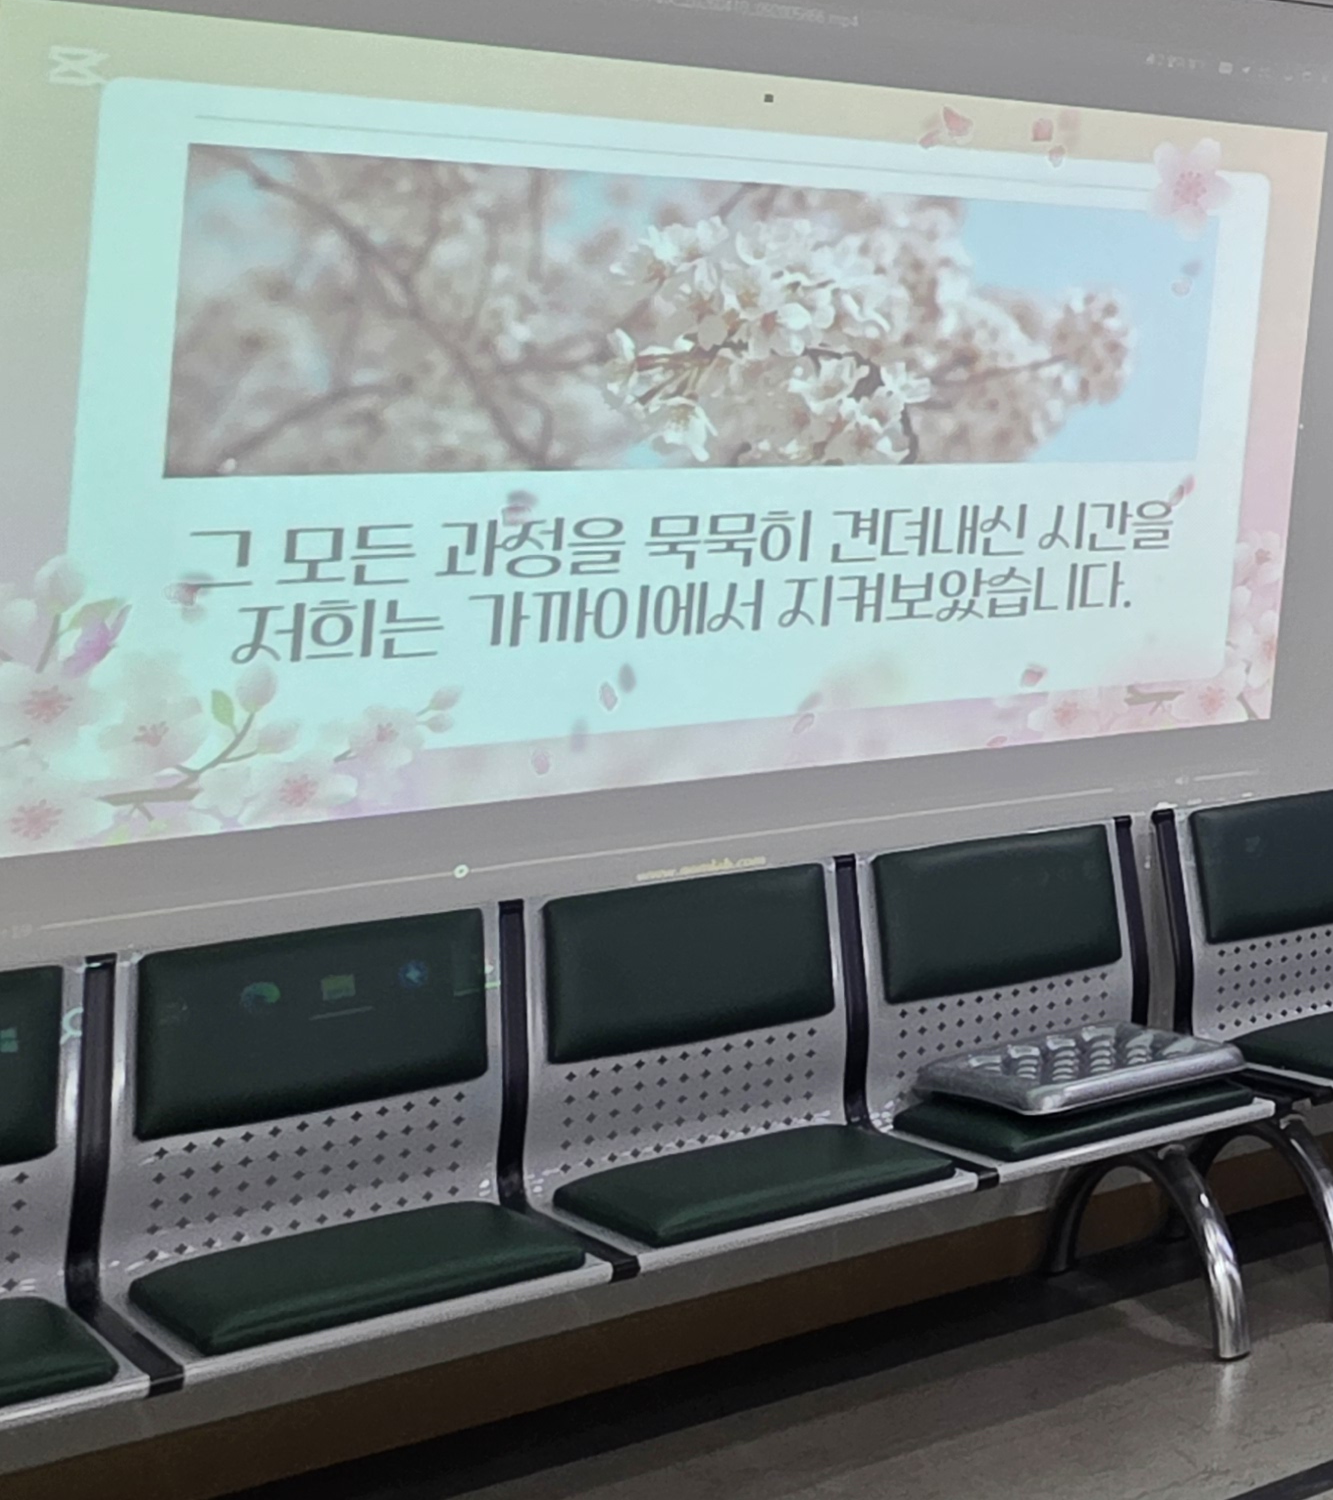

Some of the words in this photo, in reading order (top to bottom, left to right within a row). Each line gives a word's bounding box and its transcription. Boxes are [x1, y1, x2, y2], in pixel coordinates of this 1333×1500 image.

[190, 529, 254, 588] 그
[276, 523, 416, 586] 모든
[435, 516, 626, 579] 과정을
[645, 509, 813, 570] 묵묵히
[831, 503, 1029, 564] 견뎌내신
[1037, 500, 1174, 554] 시간을
[231, 597, 445, 665] 저희는
[469, 579, 765, 648] 가까이에서
[778, 560, 1133, 628] 지켜보았습니다.
